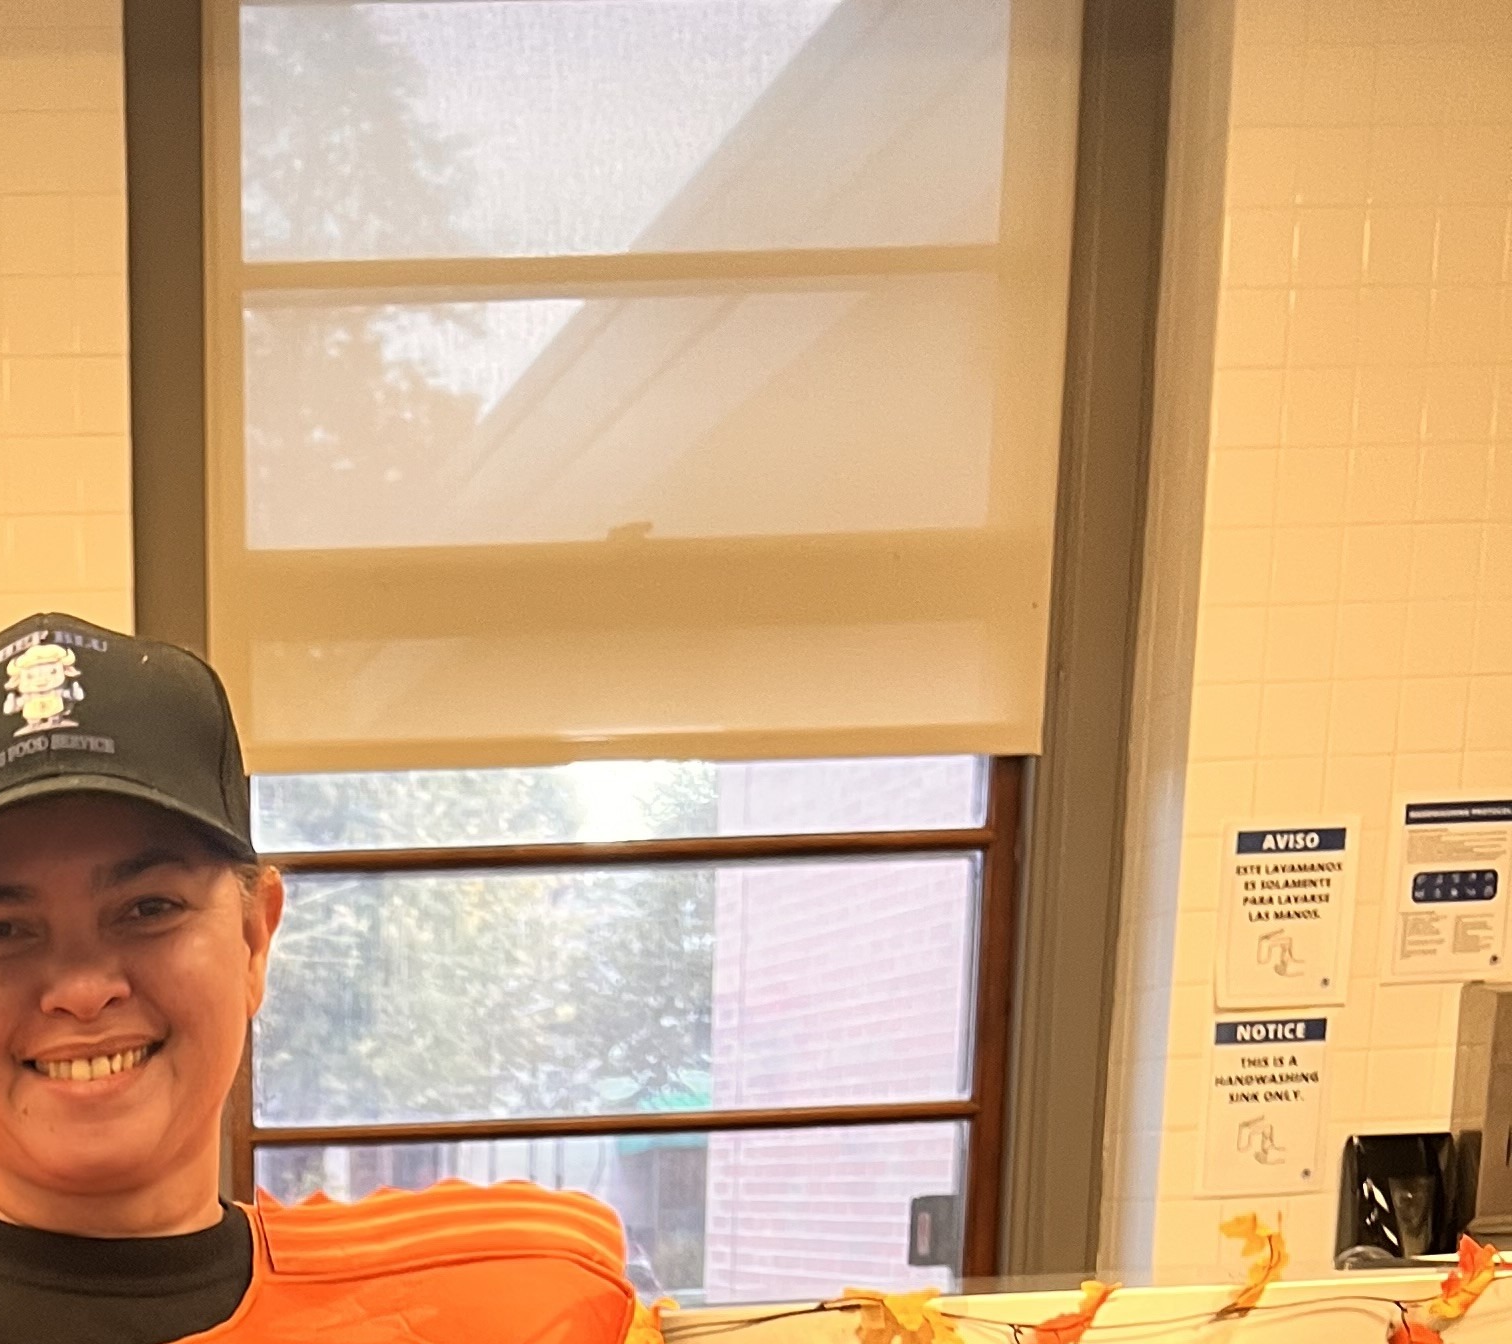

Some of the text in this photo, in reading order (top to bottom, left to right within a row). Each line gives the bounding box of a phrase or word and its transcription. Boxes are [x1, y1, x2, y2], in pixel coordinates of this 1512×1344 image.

[8, 734, 115, 762] FOOD SERVICE
[1262, 832, 1320, 850] AVISO
[1265, 862, 1343, 875] LAVAMANOS
[1261, 878, 1331, 890] SOLAMENTE
[1242, 893, 1330, 906] PARA LAVARSE
[1248, 910, 1269, 922] LAS
[1236, 1022, 1306, 1041] NOTICE
[1241, 1055, 1298, 1068] THIS IS A
[1215, 1071, 1319, 1086] HANDWASHING
[1229, 1090, 1260, 1104] SINK
